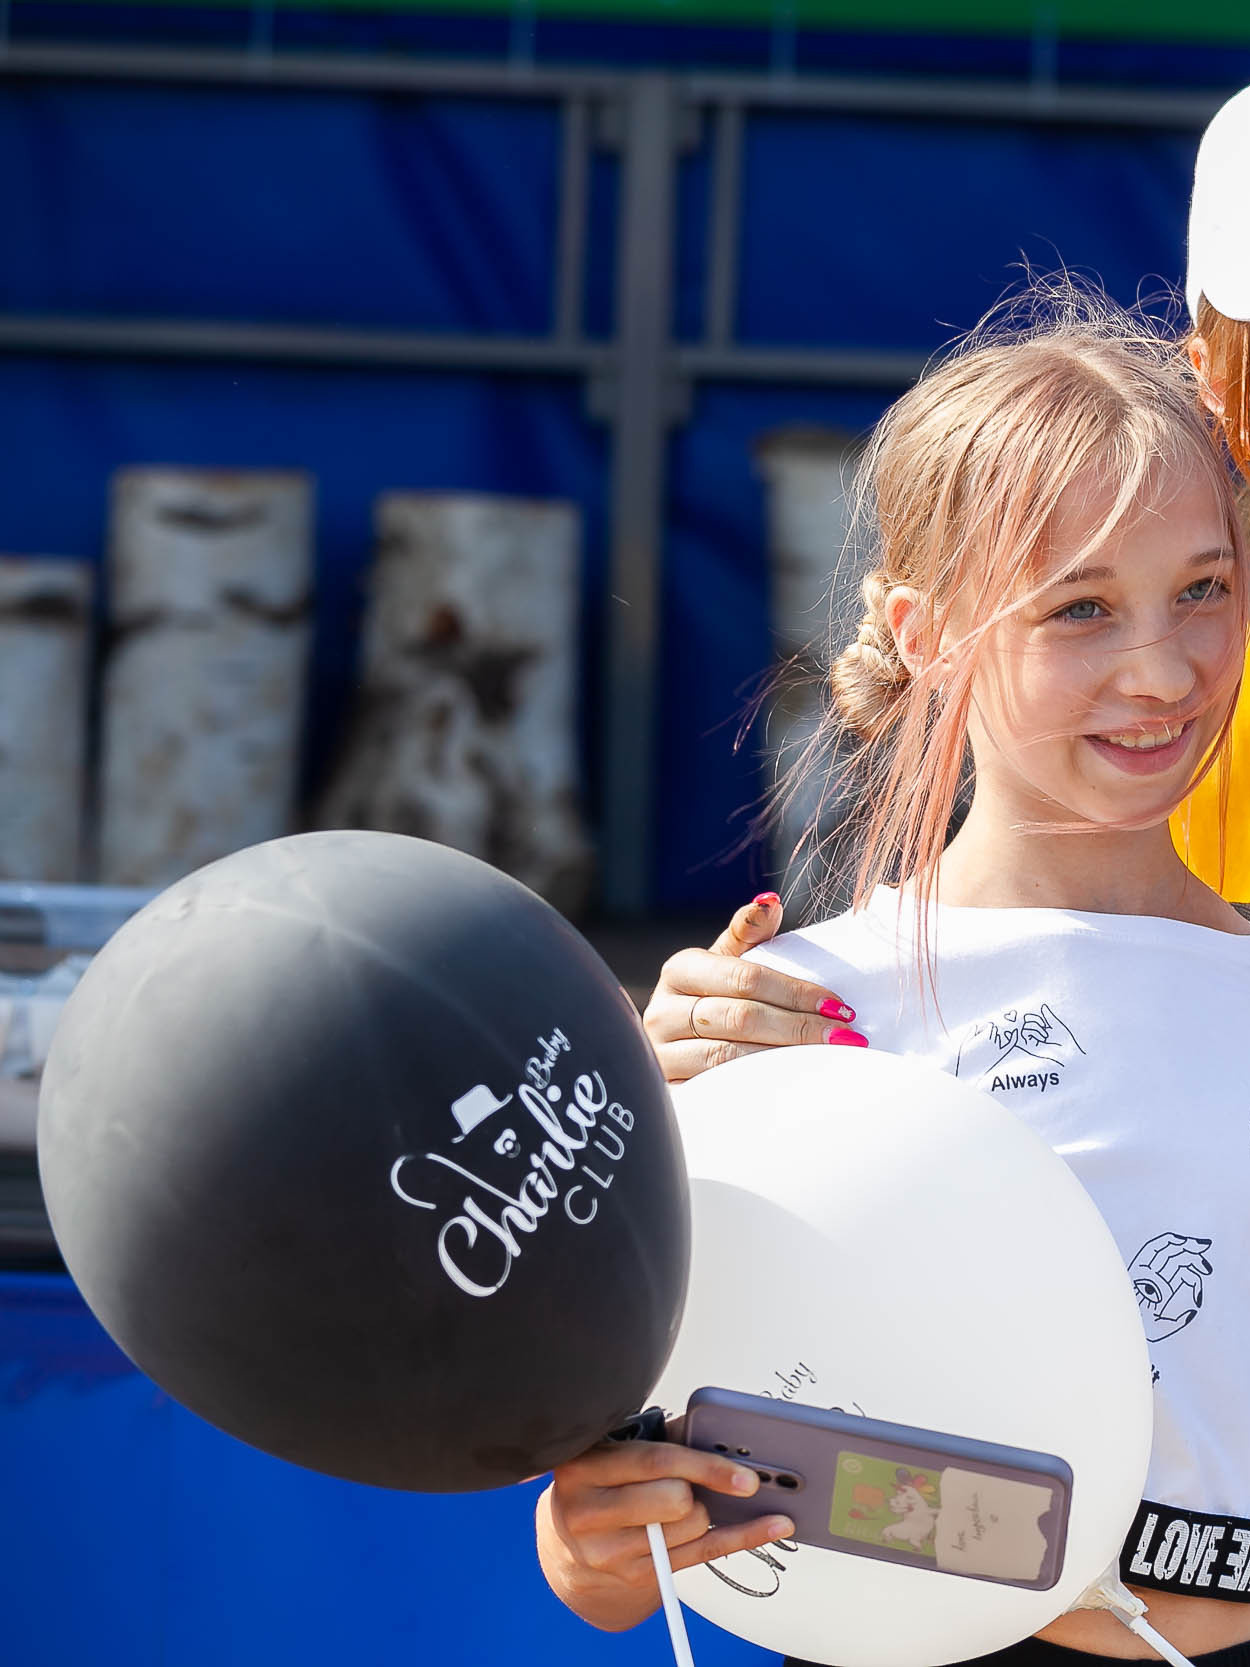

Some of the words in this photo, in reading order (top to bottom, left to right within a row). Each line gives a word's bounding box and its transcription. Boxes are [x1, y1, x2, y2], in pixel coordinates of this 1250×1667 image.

[525, 1027, 571, 1089] Baby
[991, 1070, 1060, 1092] Always
[438, 1071, 608, 1297] Charlie
[564, 1102, 635, 1225] CLUB
[1130, 1513, 1225, 1587] LOVE
